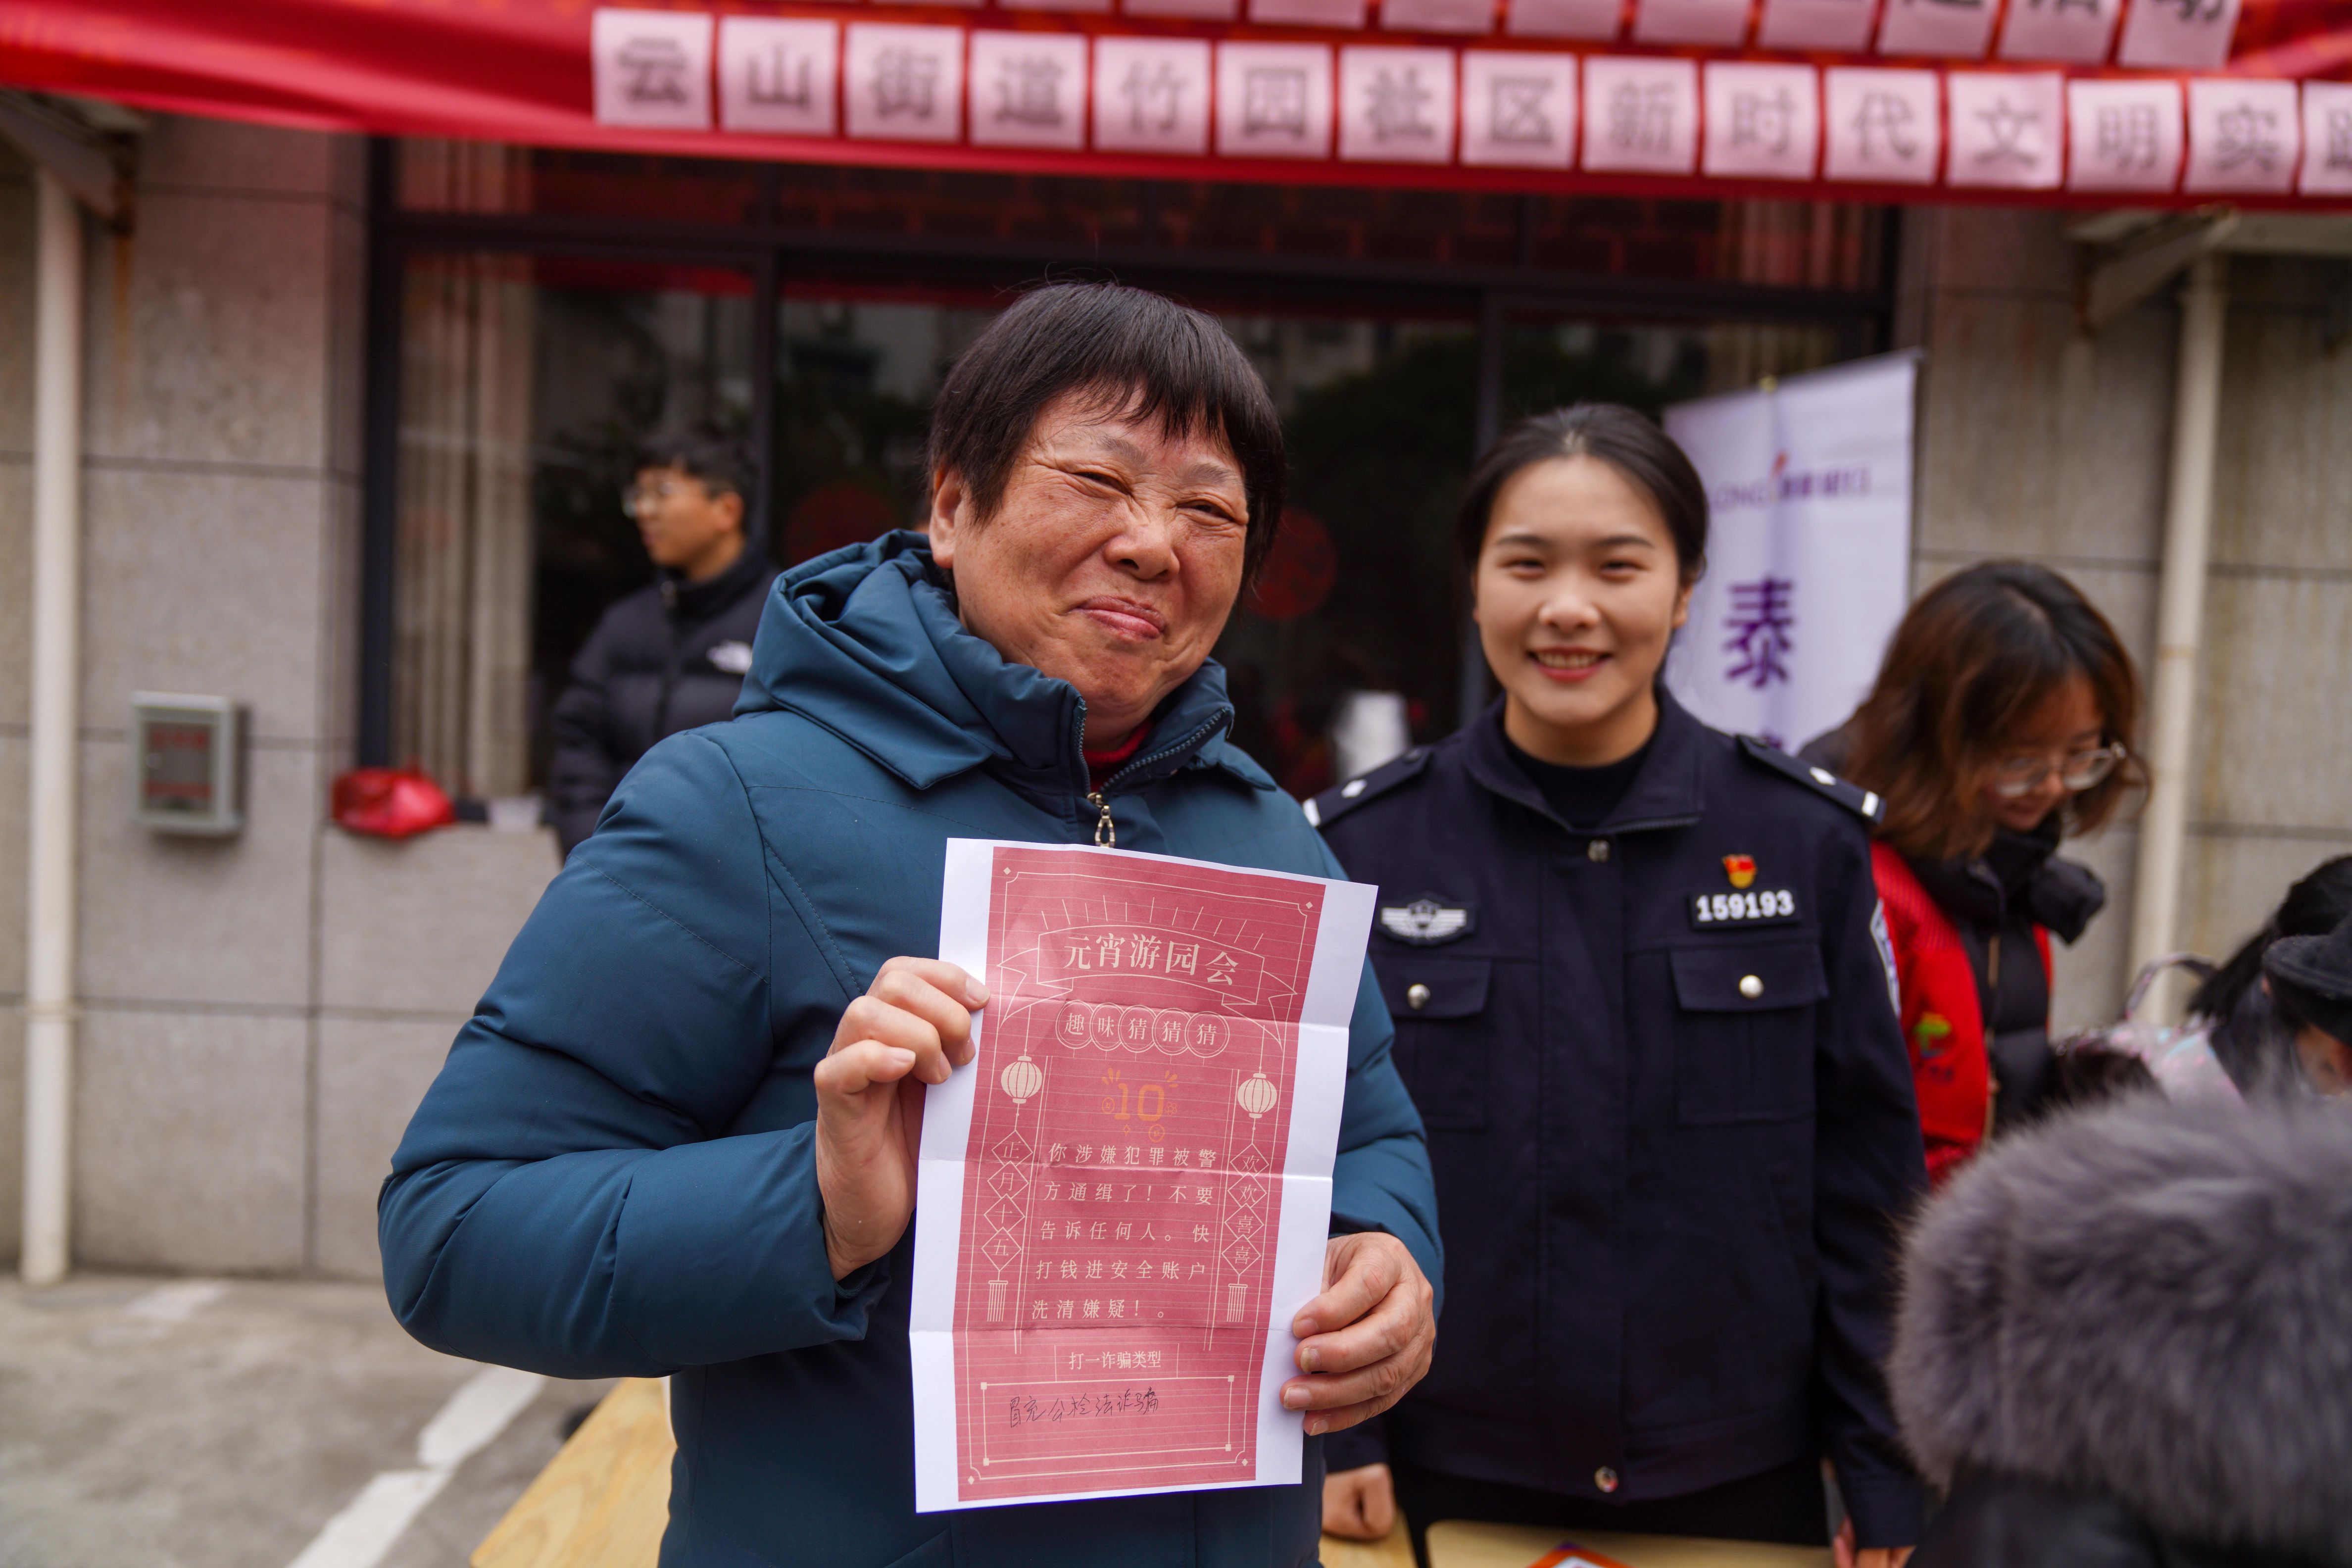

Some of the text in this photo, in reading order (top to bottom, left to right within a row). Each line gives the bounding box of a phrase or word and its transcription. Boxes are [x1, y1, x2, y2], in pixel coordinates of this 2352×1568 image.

[1723, 575, 1796, 689] 泰
[1695, 888, 1796, 923] 159193
[1063, 932, 1239, 986] 元宵游园会
[1064, 1012, 1218, 1046] 趣味猜猜猜
[1114, 1082, 1165, 1122] 10
[1048, 1142, 1217, 1168] 你涉嫌犯罪被警
[991, 1140, 1021, 1256] 正月十五
[1044, 1182, 1214, 1206] 方通缉了！不要
[1232, 1153, 1264, 1265] 欢欢喜喜
[1040, 1220, 1210, 1243] 告诉任何人。快
[1035, 1260, 1206, 1281] 打钱进安全账户
[1068, 1350, 1161, 1370] 打一诈骗类型
[1011, 1386, 1159, 1428] 冒充公检法诈骗
